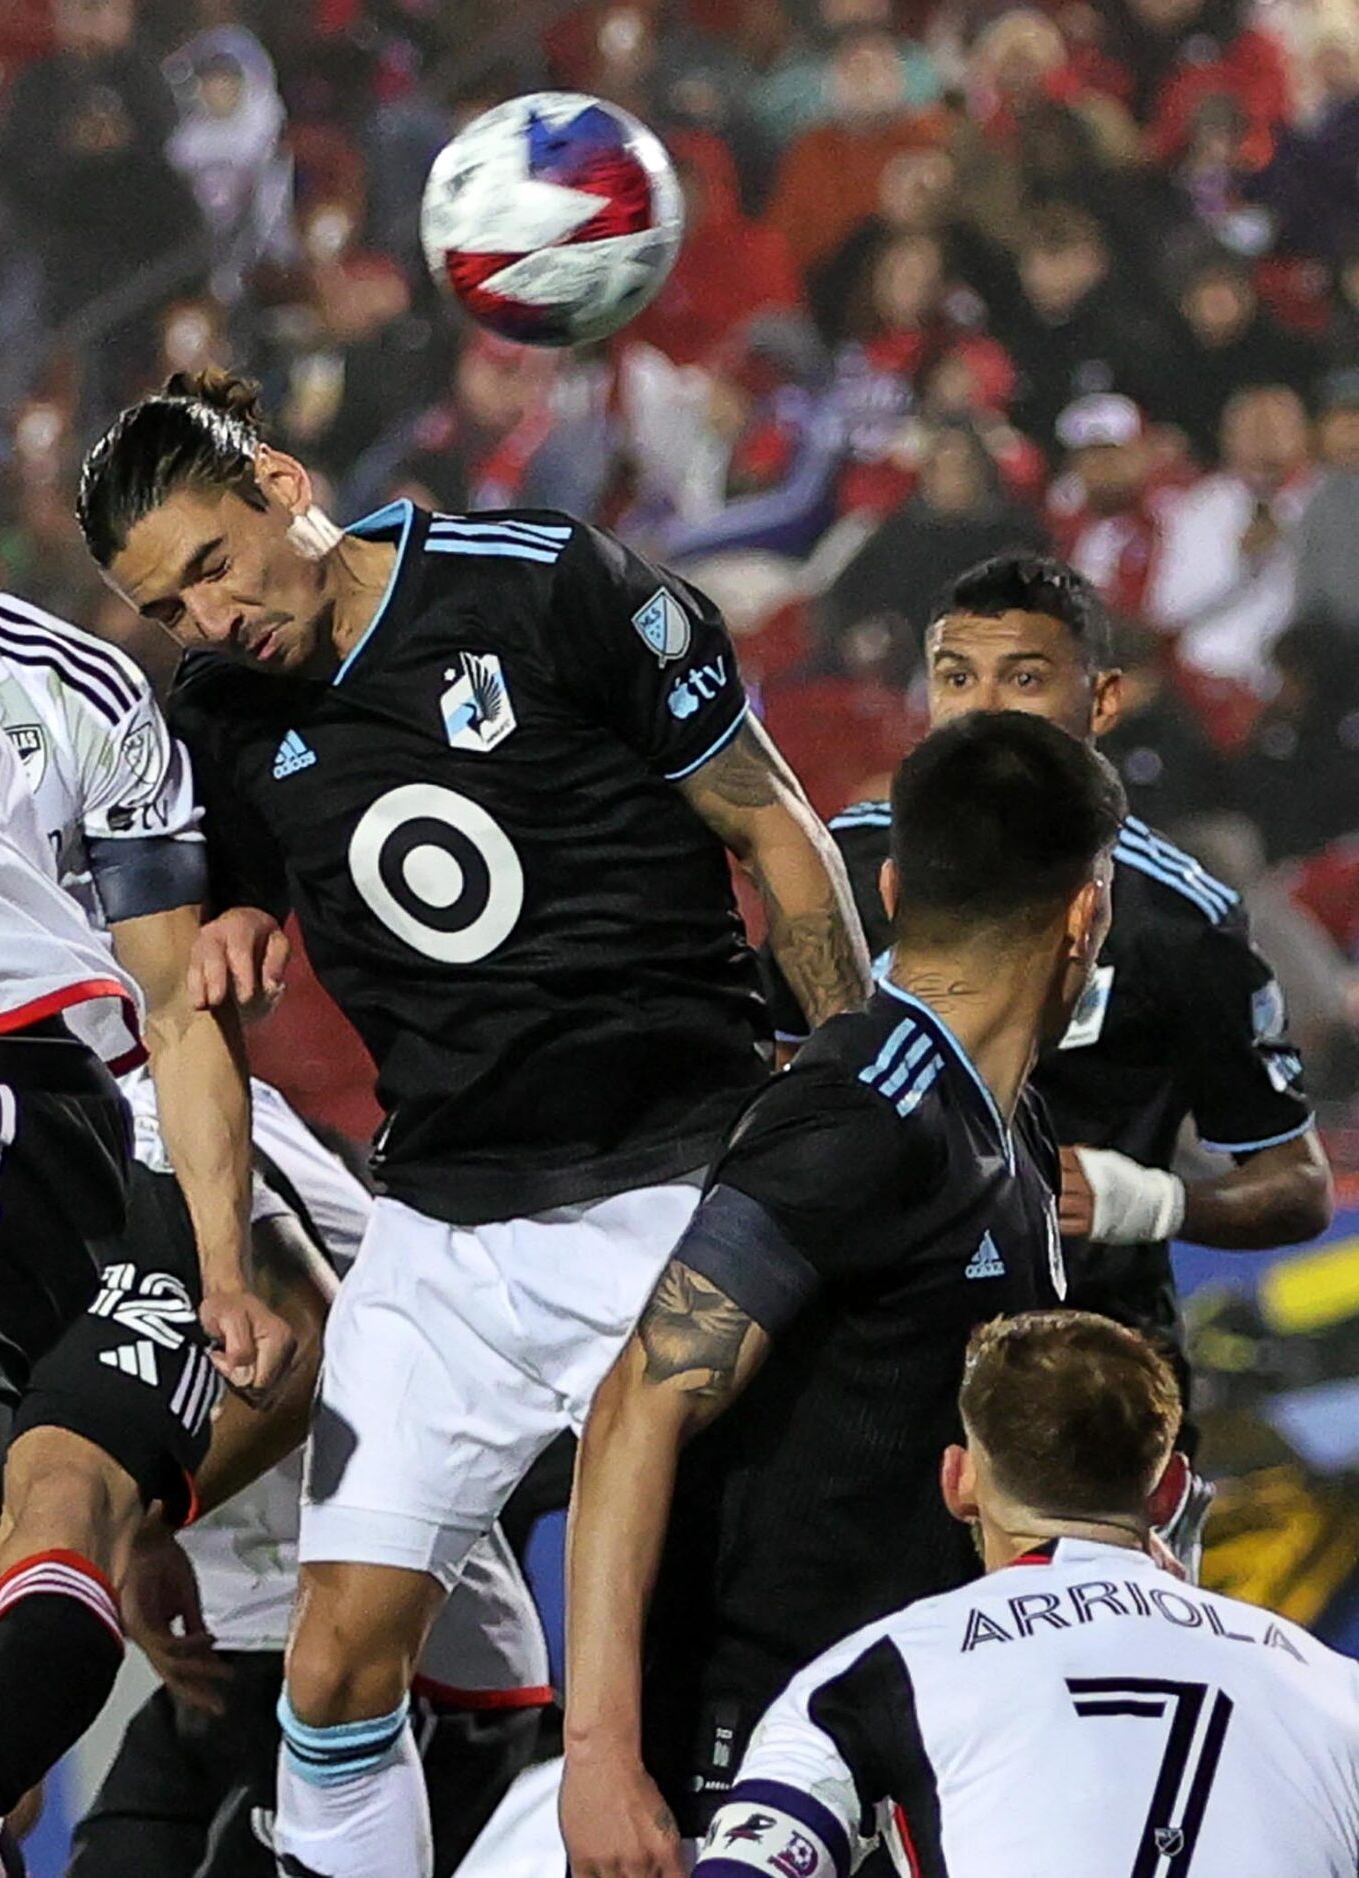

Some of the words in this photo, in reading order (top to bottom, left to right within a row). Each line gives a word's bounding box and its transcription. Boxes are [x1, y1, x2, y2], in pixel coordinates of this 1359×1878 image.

[689, 655, 727, 699] tv
[273, 750, 317, 779] adidas
[87, 1262, 197, 1350] 12
[960, 1580, 1311, 1665] ARRIOLA
[1064, 1677, 1234, 1878] 7
